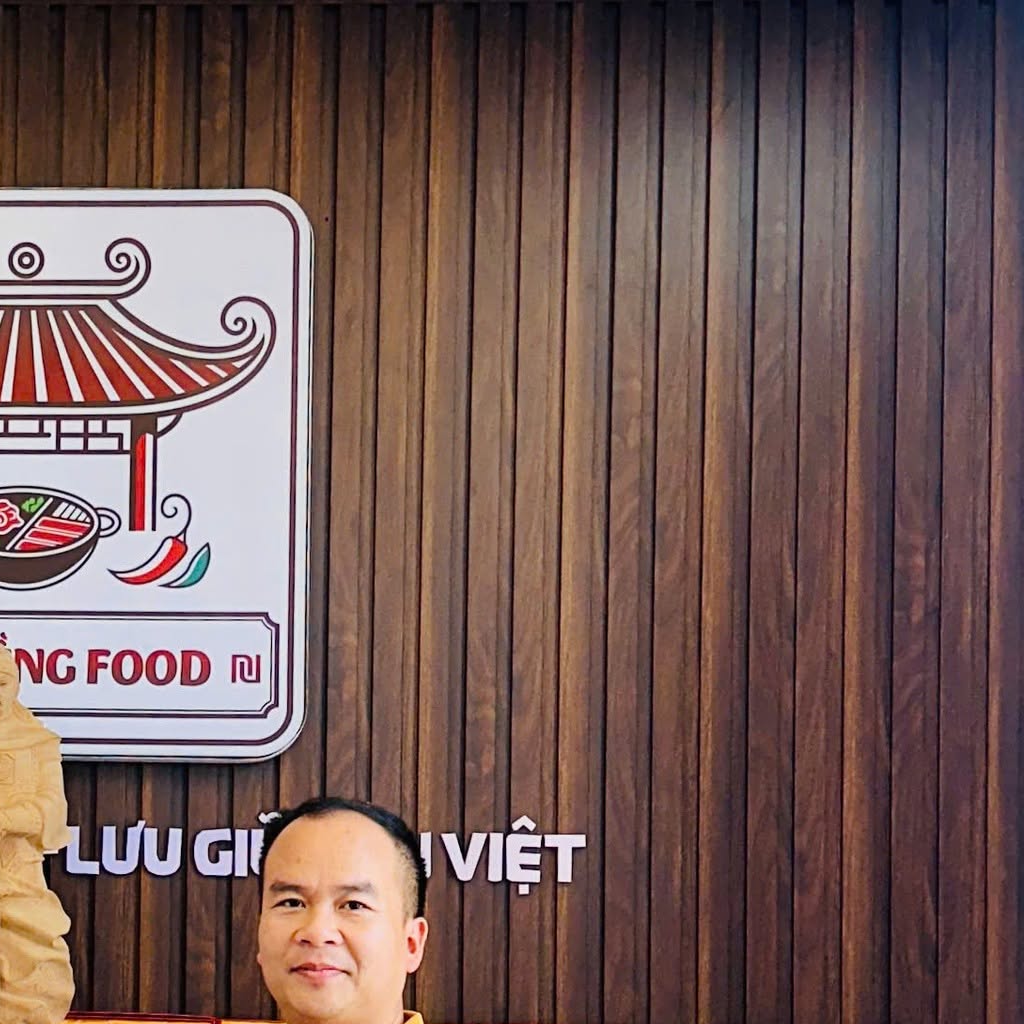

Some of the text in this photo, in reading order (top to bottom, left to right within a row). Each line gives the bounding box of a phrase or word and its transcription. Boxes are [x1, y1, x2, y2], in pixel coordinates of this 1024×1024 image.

[86, 647, 213, 687] FOOD
[66, 819, 183, 876] LƯU
[440, 814, 587, 896] VIỆT
